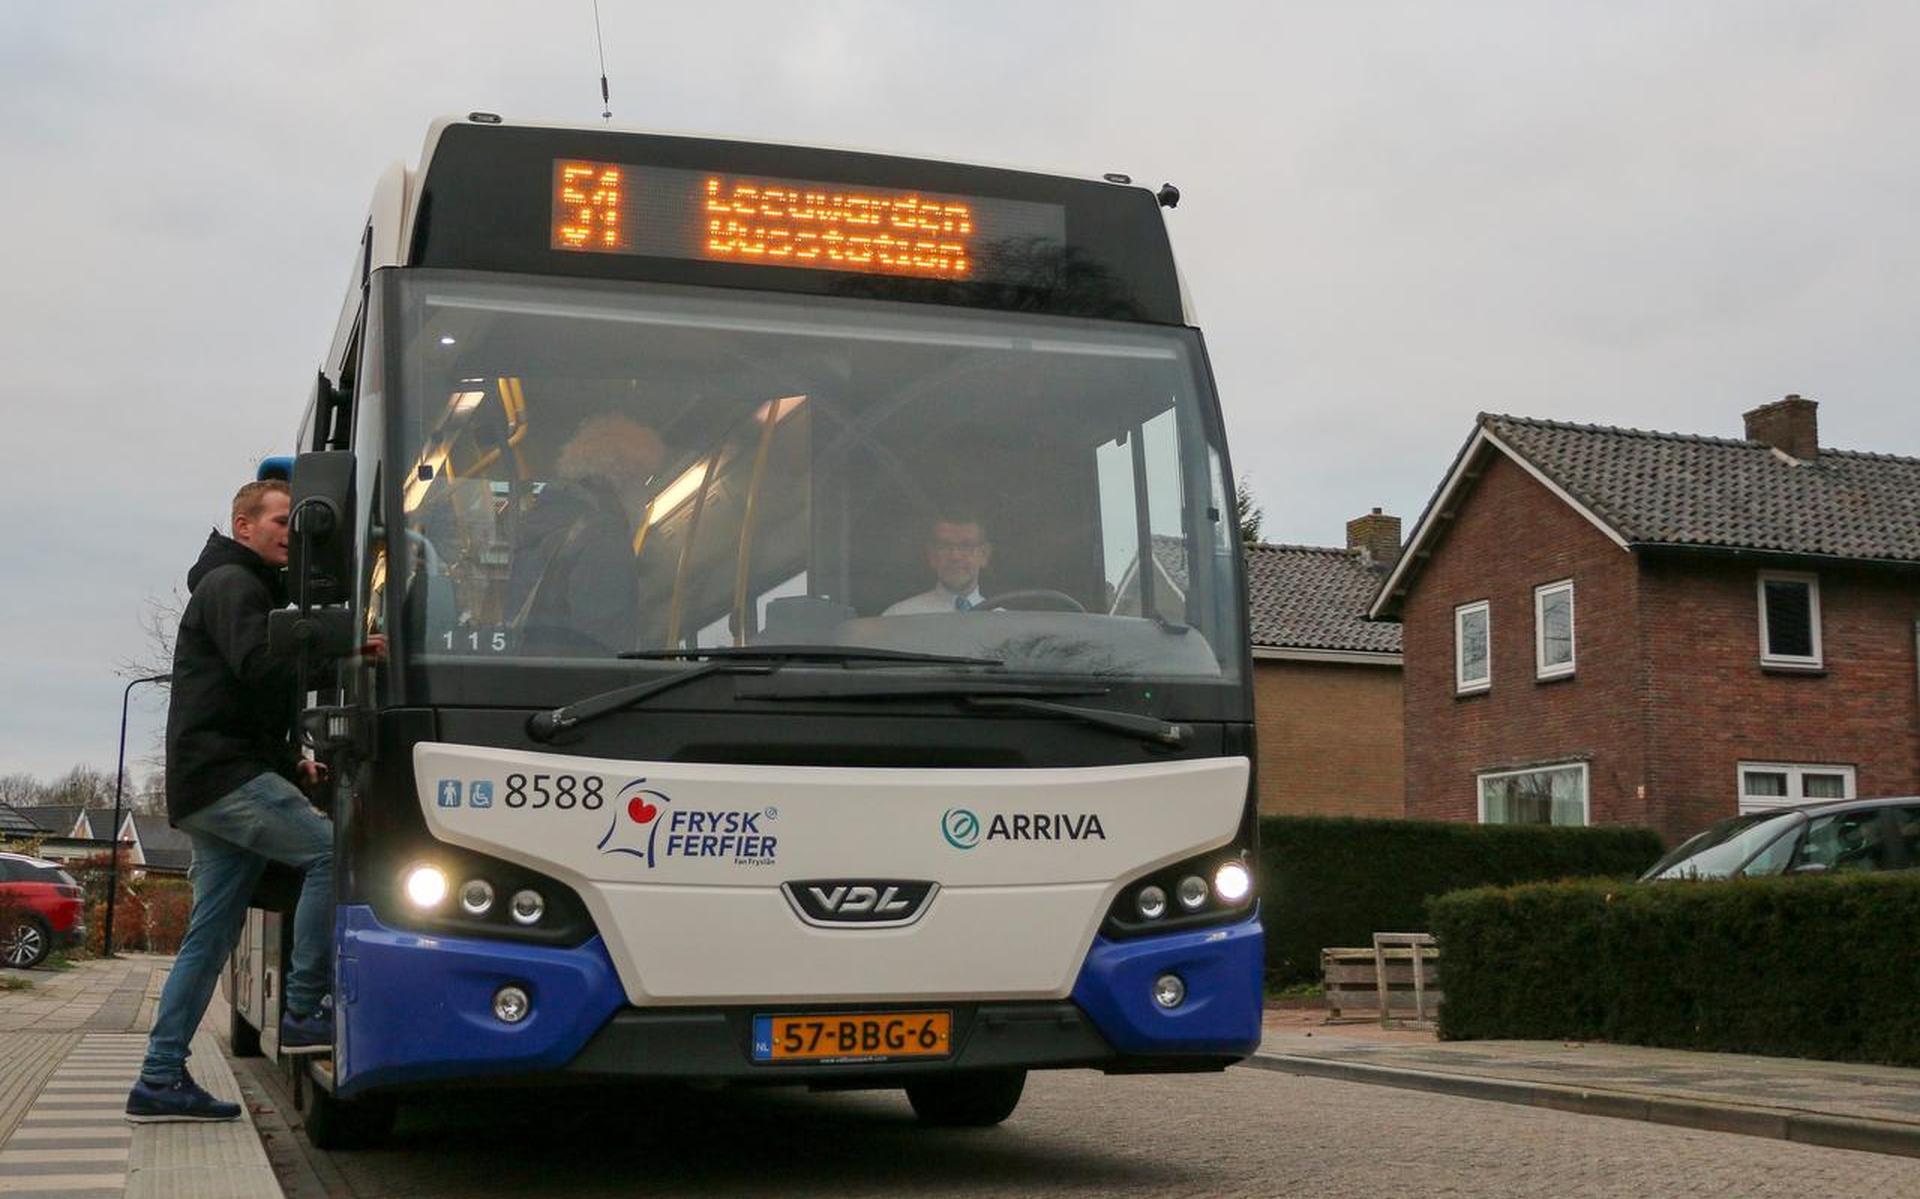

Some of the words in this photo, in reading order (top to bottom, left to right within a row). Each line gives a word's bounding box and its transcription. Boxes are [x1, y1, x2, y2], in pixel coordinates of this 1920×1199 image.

[563, 169, 618, 245] 51
[708, 181, 969, 233] Leeuwarden
[505, 773, 603, 810] 8588
[671, 811, 761, 833] FRYSK
[987, 814, 1106, 840] ARRIVA
[666, 835, 778, 857] FERFIER
[808, 885, 909, 914] VDL
[756, 1042, 770, 1052] NL
[784, 1019, 938, 1052] 57-BBG-6
